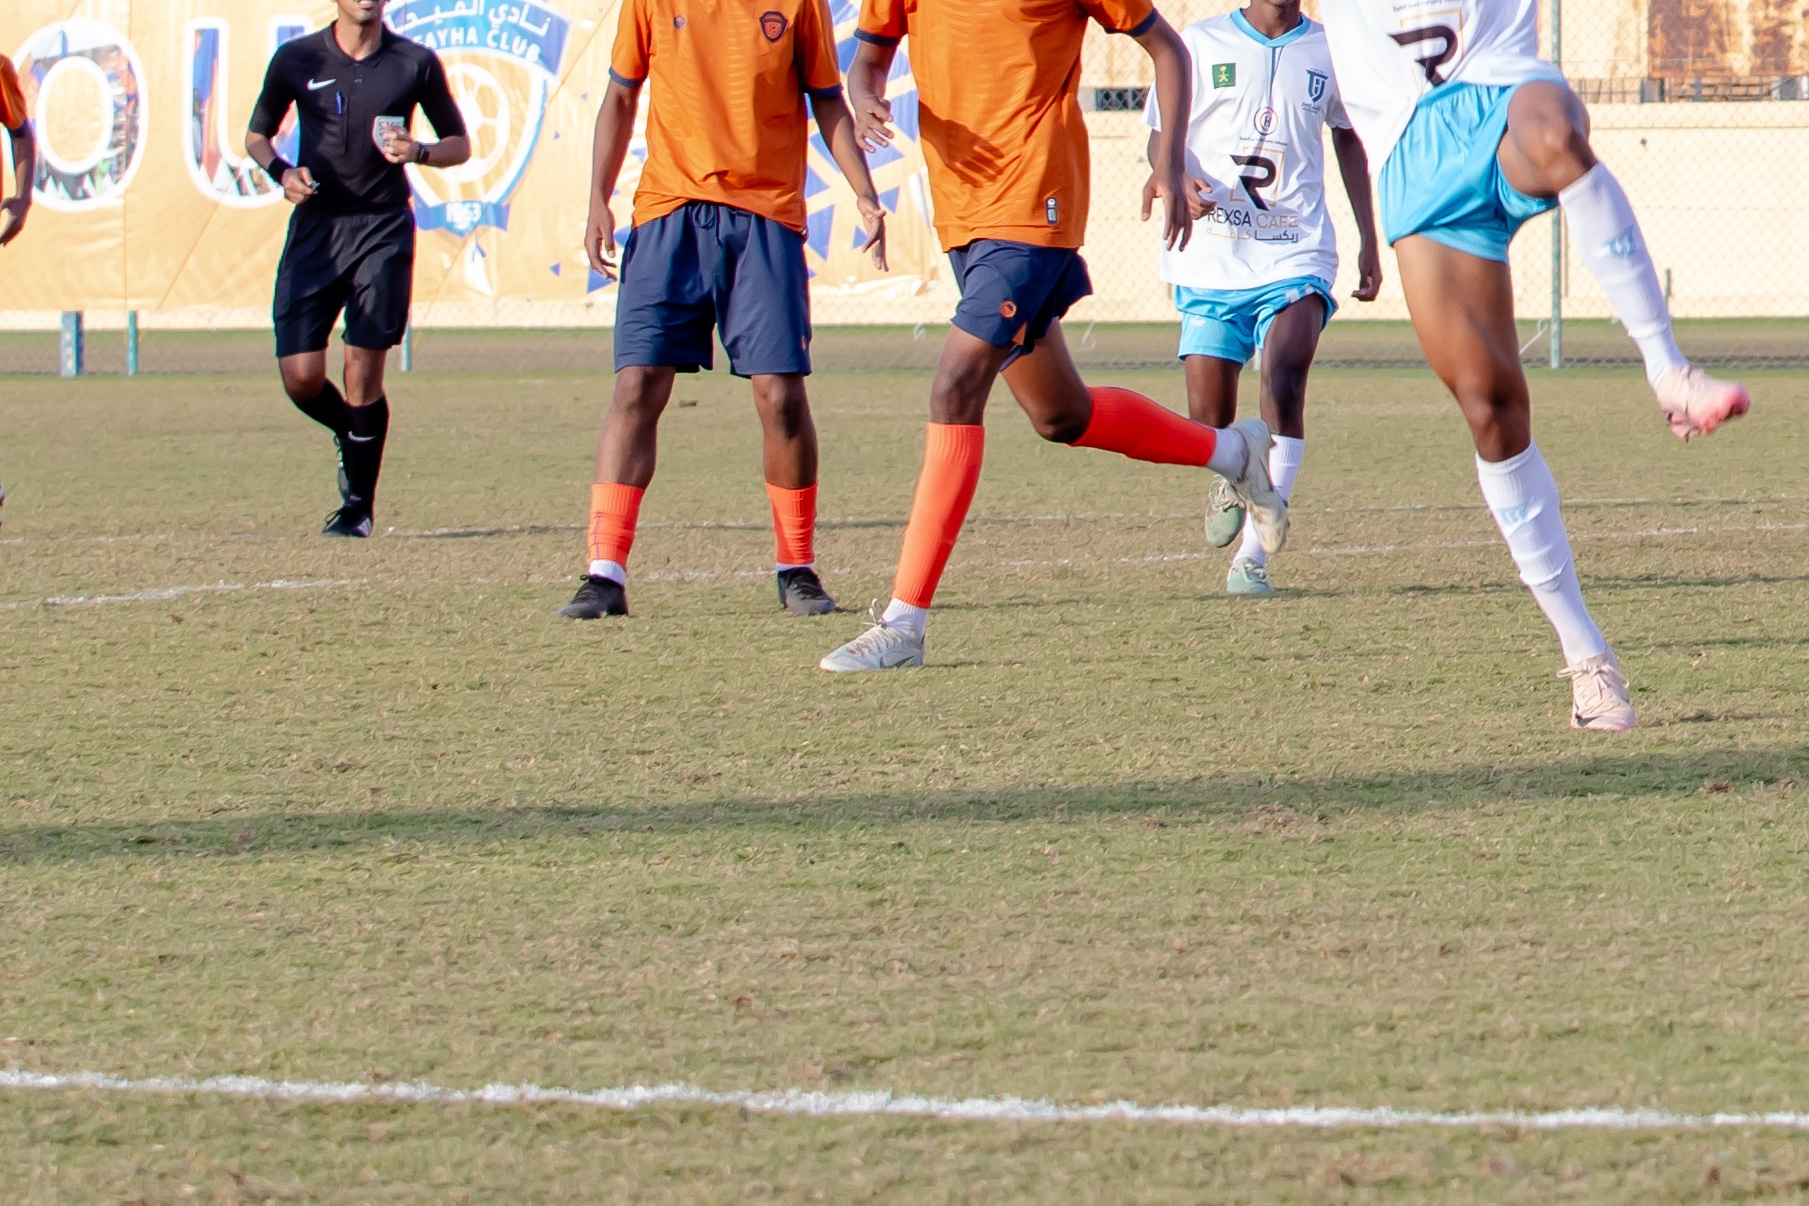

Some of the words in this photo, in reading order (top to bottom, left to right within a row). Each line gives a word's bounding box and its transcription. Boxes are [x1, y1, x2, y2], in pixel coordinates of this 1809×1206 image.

[486, 28, 541, 62] CLUB
[1207, 206, 1252, 228] REXSA
[1255, 213, 1299, 230] CAFE
